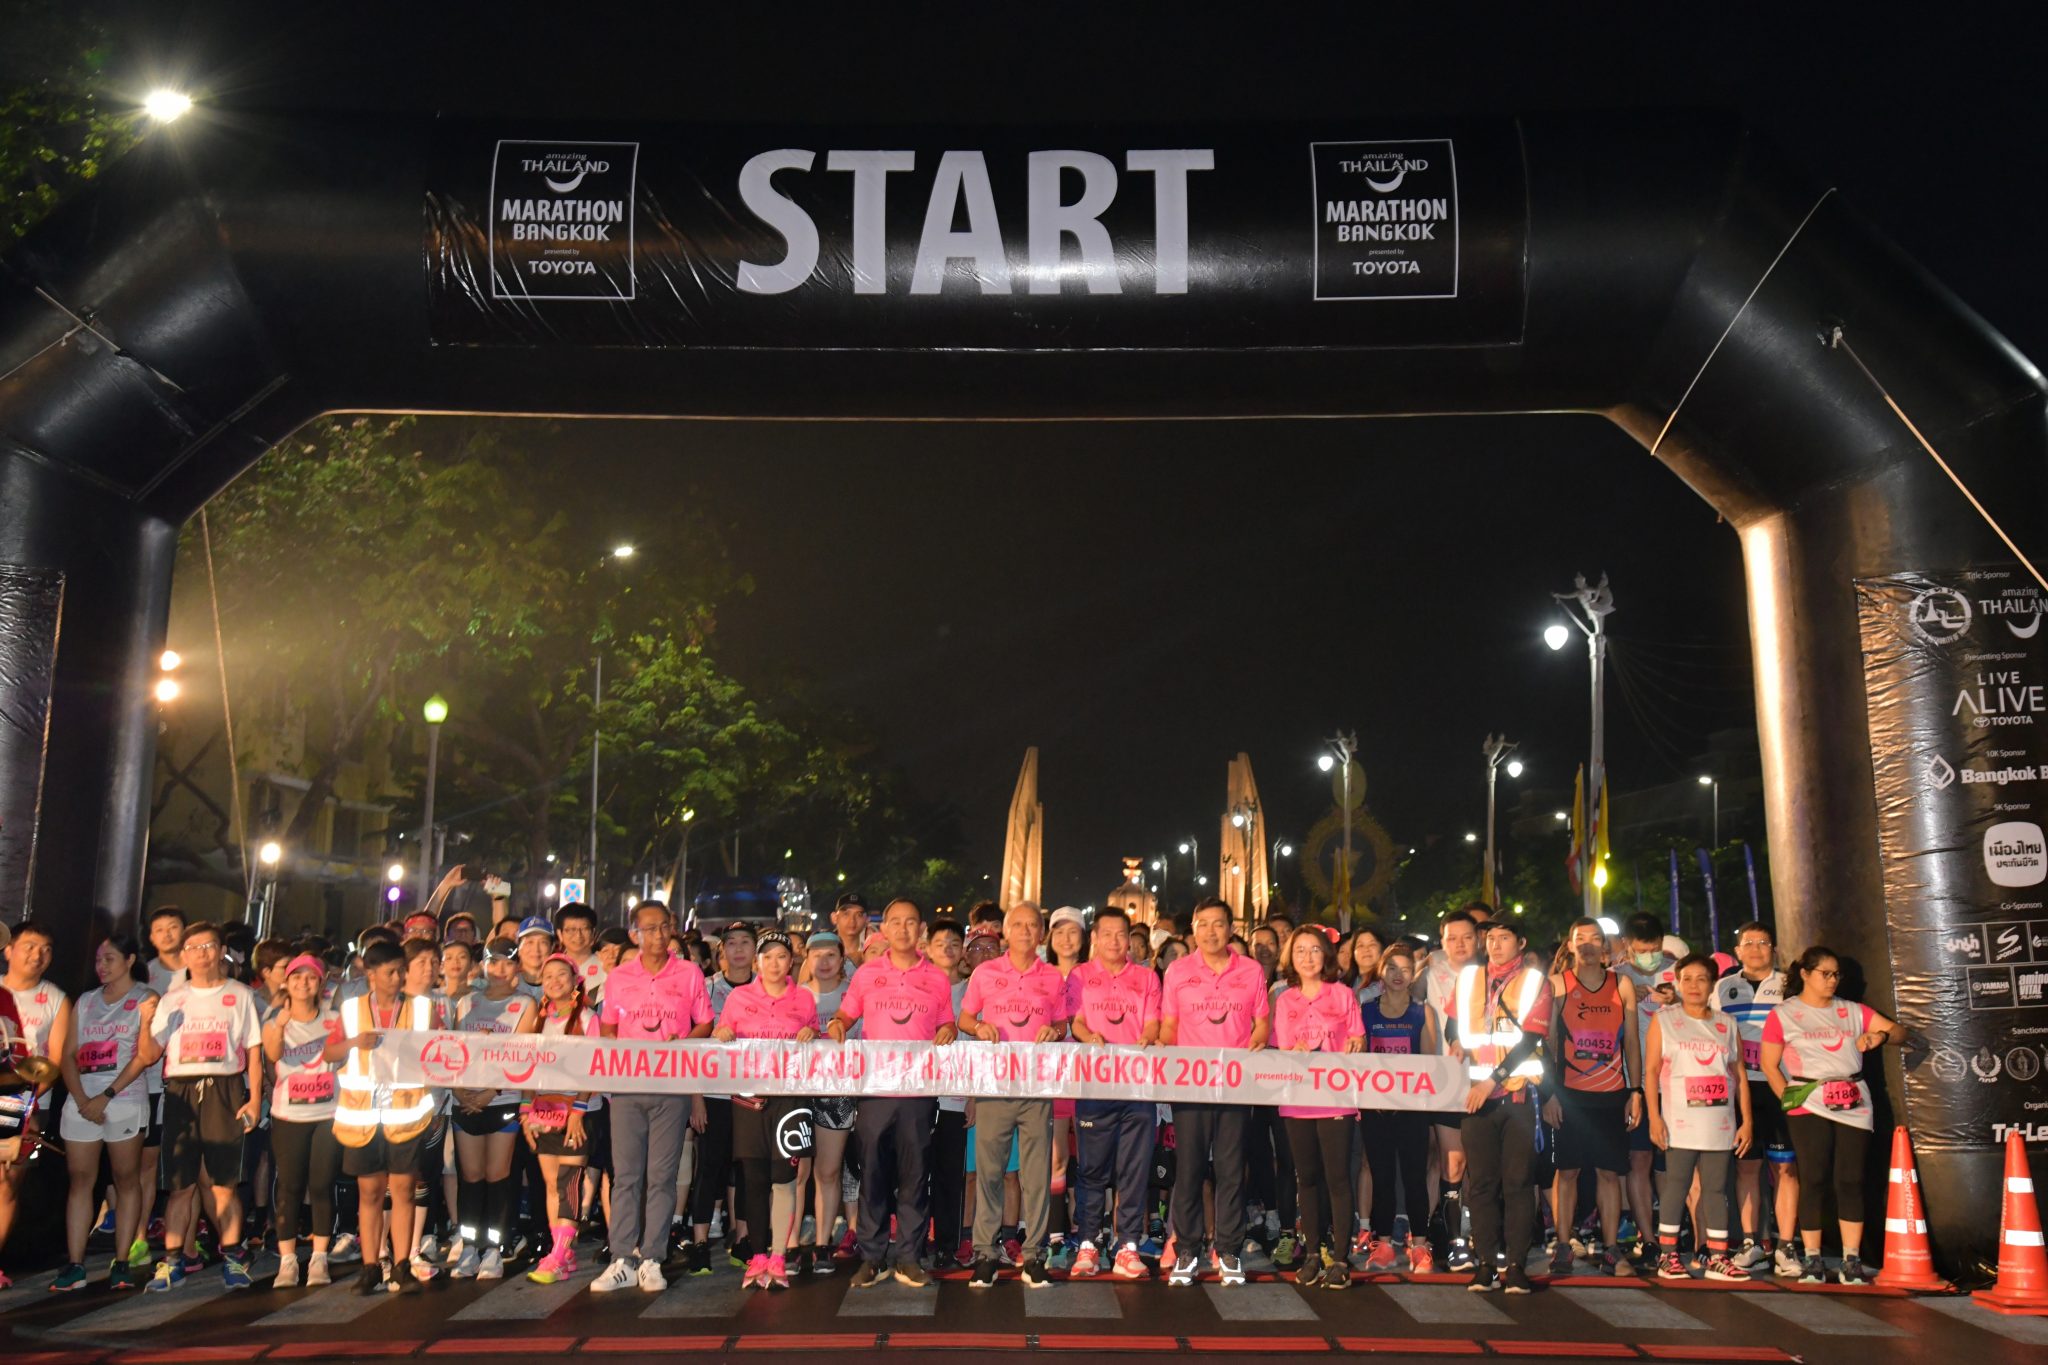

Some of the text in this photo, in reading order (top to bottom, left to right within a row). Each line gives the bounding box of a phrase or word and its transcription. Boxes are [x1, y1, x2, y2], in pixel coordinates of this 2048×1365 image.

[545, 152, 588, 161] amazing
[1362, 151, 1405, 160] amazing
[521, 159, 610, 173] THAILAND
[1338, 159, 1429, 173] THAILAND
[502, 199, 623, 222] MARATHON
[1326, 198, 1447, 223] MARATHON
[736, 148, 1215, 294] START
[513, 223, 610, 241] BANGKOK
[1338, 223, 1436, 242] BANGKOK
[572, 248, 580, 256] by
[528, 260, 597, 275] TOYOTA
[1352, 260, 1421, 275] TOYOTA
[1967, 571, 2010, 580] Title Sponsor
[2001, 587, 2039, 598] amazing
[1965, 651, 2027, 661] Presenting Sponsor
[1977, 671, 2021, 686] LIVE
[1952, 686, 2046, 716] ALIVE
[1991, 716, 2034, 725] TOYOTA
[1986, 749, 2026, 758] 10K Sponsor
[1961, 765, 2038, 785] Bangkok
[2004, 803, 2031, 811] Sponsor
[1981, 981, 2010, 990] YAMAHA
[2019, 984, 2042, 996] VITAL
[874, 1001, 929, 1014] THAILAND
[992, 1005, 1044, 1017] THAILAND
[1191, 1001, 1243, 1013] THAILAND
[628, 1008, 678, 1021] THAILAND
[178, 1020, 230, 1033] THAILAND
[181, 1038, 223, 1051] 40168
[501, 1041, 537, 1050] amazing
[1577, 1038, 1613, 1050] 40452
[1679, 1040, 1729, 1055] THAILAND
[482, 1047, 557, 1064] THAILAND
[588, 1047, 719, 1079] AMAZING
[1036, 1052, 1168, 1085] BANGKOK
[1174, 1057, 1242, 1088] 2020
[1255, 1070, 1293, 1082] presented
[1293, 1071, 1304, 1083] by
[1308, 1067, 1437, 1095] TOYOTA
[291, 1079, 331, 1094] 40056
[1689, 1082, 1726, 1095] 40479
